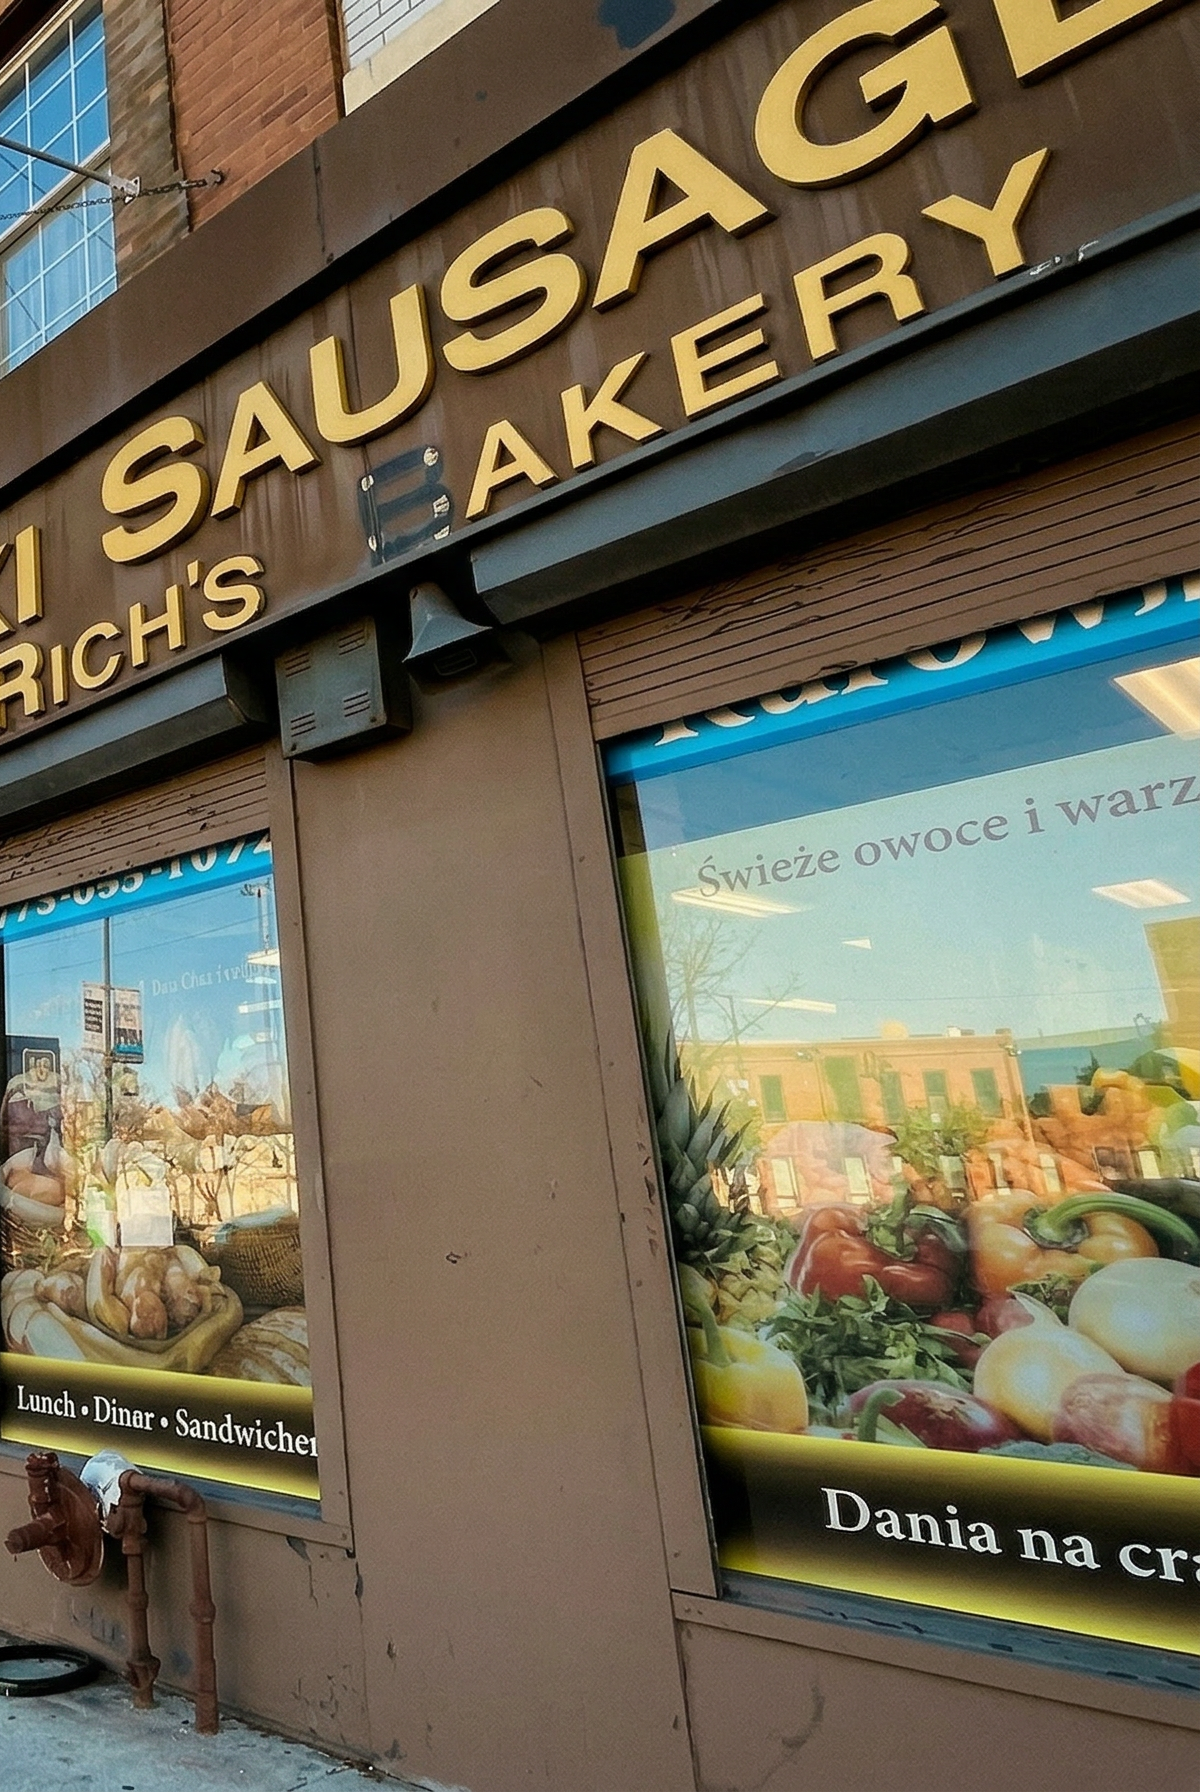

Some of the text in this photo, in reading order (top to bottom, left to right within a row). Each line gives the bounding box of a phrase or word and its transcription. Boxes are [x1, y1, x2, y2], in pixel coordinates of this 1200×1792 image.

[697, 845, 841, 898] Świeże
[854, 813, 1010, 868] owoce
[1025, 797, 1046, 835] i
[16, 1384, 77, 1419] Lunch
[820, 1486, 1003, 1555] Dania
[1016, 1528, 1102, 1570] na
